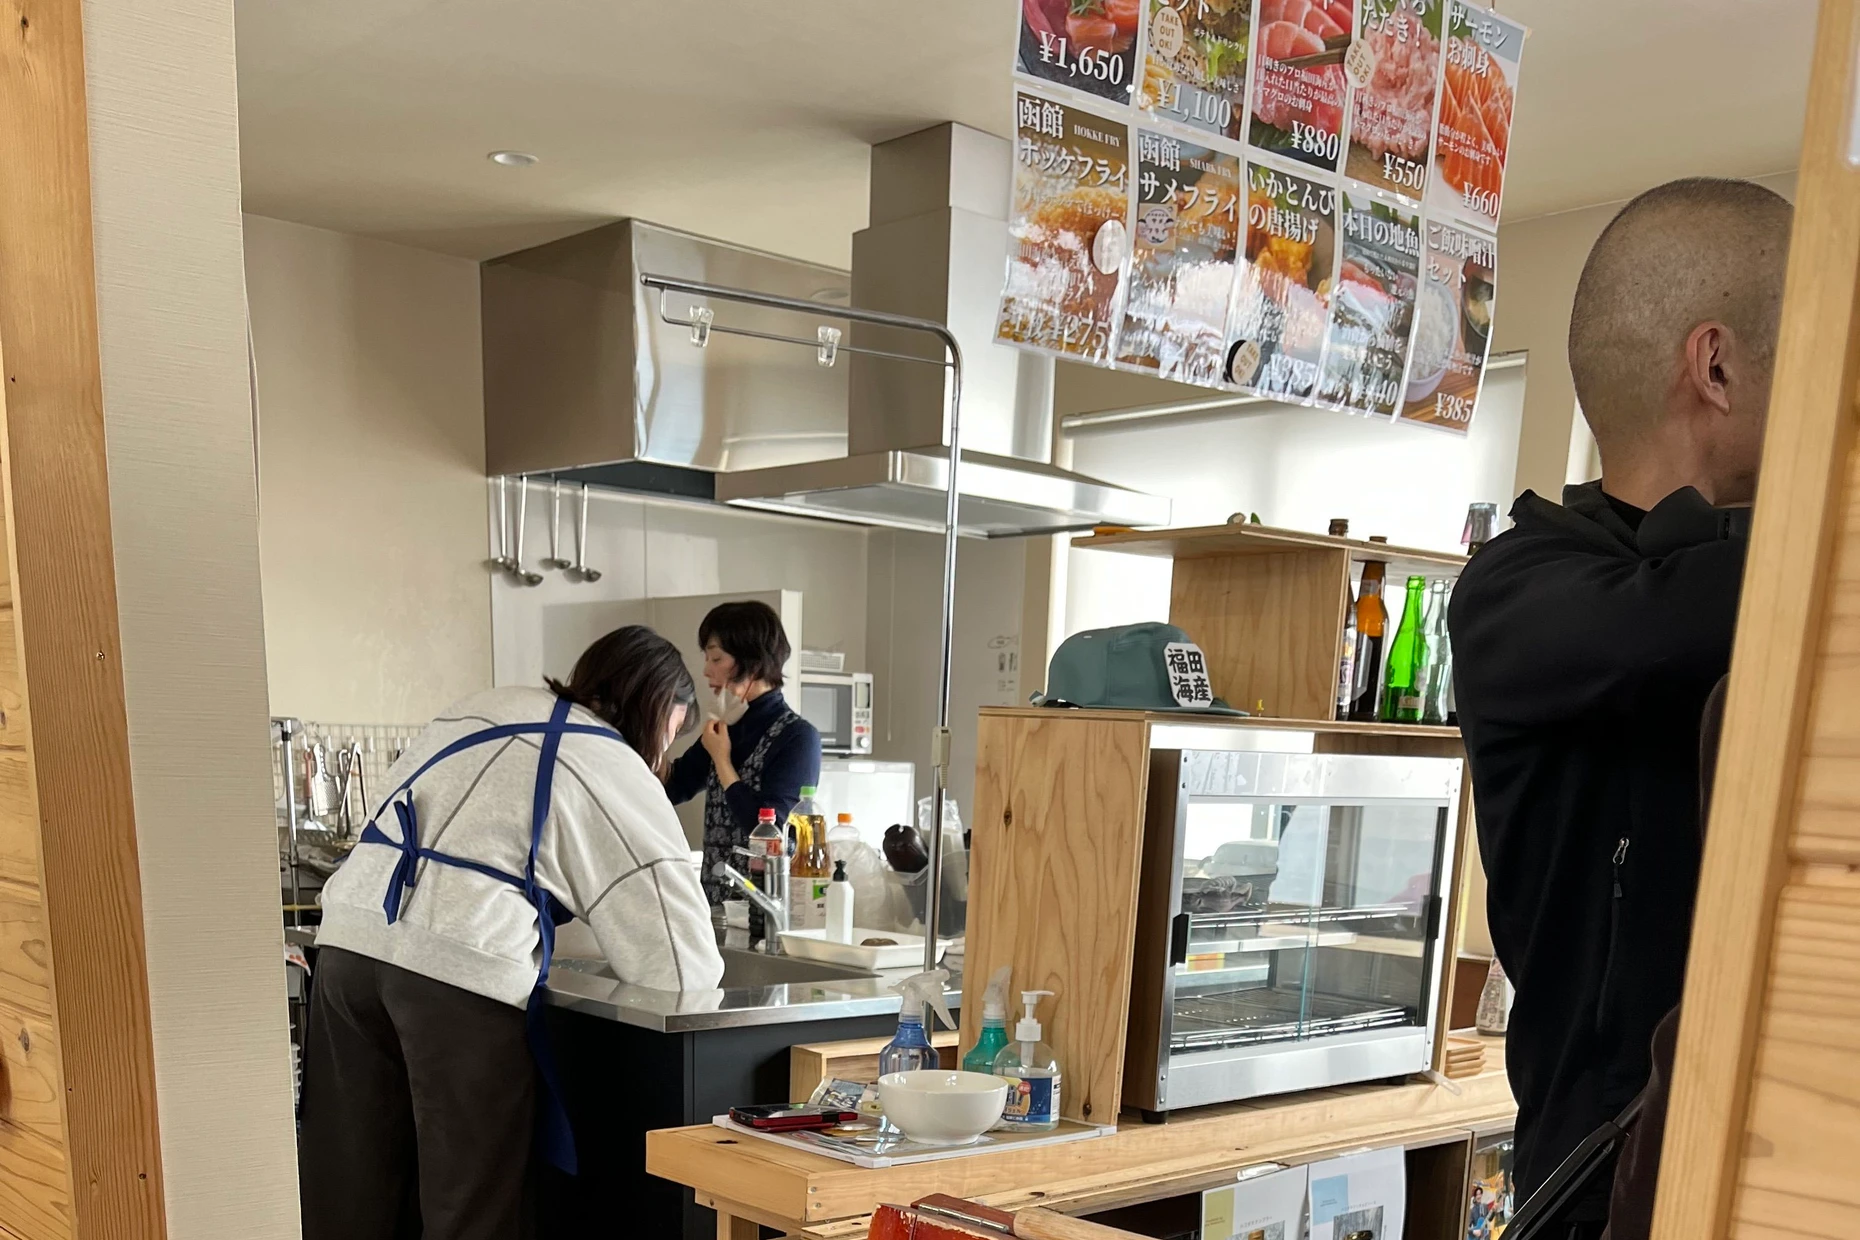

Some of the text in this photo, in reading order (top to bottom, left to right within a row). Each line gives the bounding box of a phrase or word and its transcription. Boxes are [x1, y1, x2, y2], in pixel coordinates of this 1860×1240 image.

[1159, 27, 1175, 40] OUT
[1161, 12, 1180, 28] TAKE
[1451, 5, 1508, 47] サーモン
[1038, 30, 1124, 86] ¥1,650
[1158, 39, 1173, 51] OK!
[1353, 54, 1367, 75] OUT
[1448, 41, 1490, 78] お刺身
[1359, 65, 1372, 84] OK!
[1018, 97, 1064, 140] 函館
[1157, 78, 1232, 129] ¥1,100
[1074, 124, 1122, 148] HOKKE FRY
[1139, 134, 1182, 173] 函館
[1290, 119, 1340, 162] ¥880
[1019, 137, 1130, 193] ホッケフライ
[1383, 152, 1426, 191] ¥550
[1139, 171, 1238, 223] サメフライ
[1248, 167, 1335, 216] いかとんび
[1462, 181, 1499, 218] ¥660
[1249, 203, 1319, 247] の唐揚げ
[1343, 207, 1420, 258] 本日の地魚
[1428, 224, 1495, 269] ご飯味噌汁
[1427, 256, 1467, 290] セット
[1433, 391, 1474, 424] ¥385
[1167, 648, 1204, 674] 福田
[1172, 674, 1211, 703] 海産
